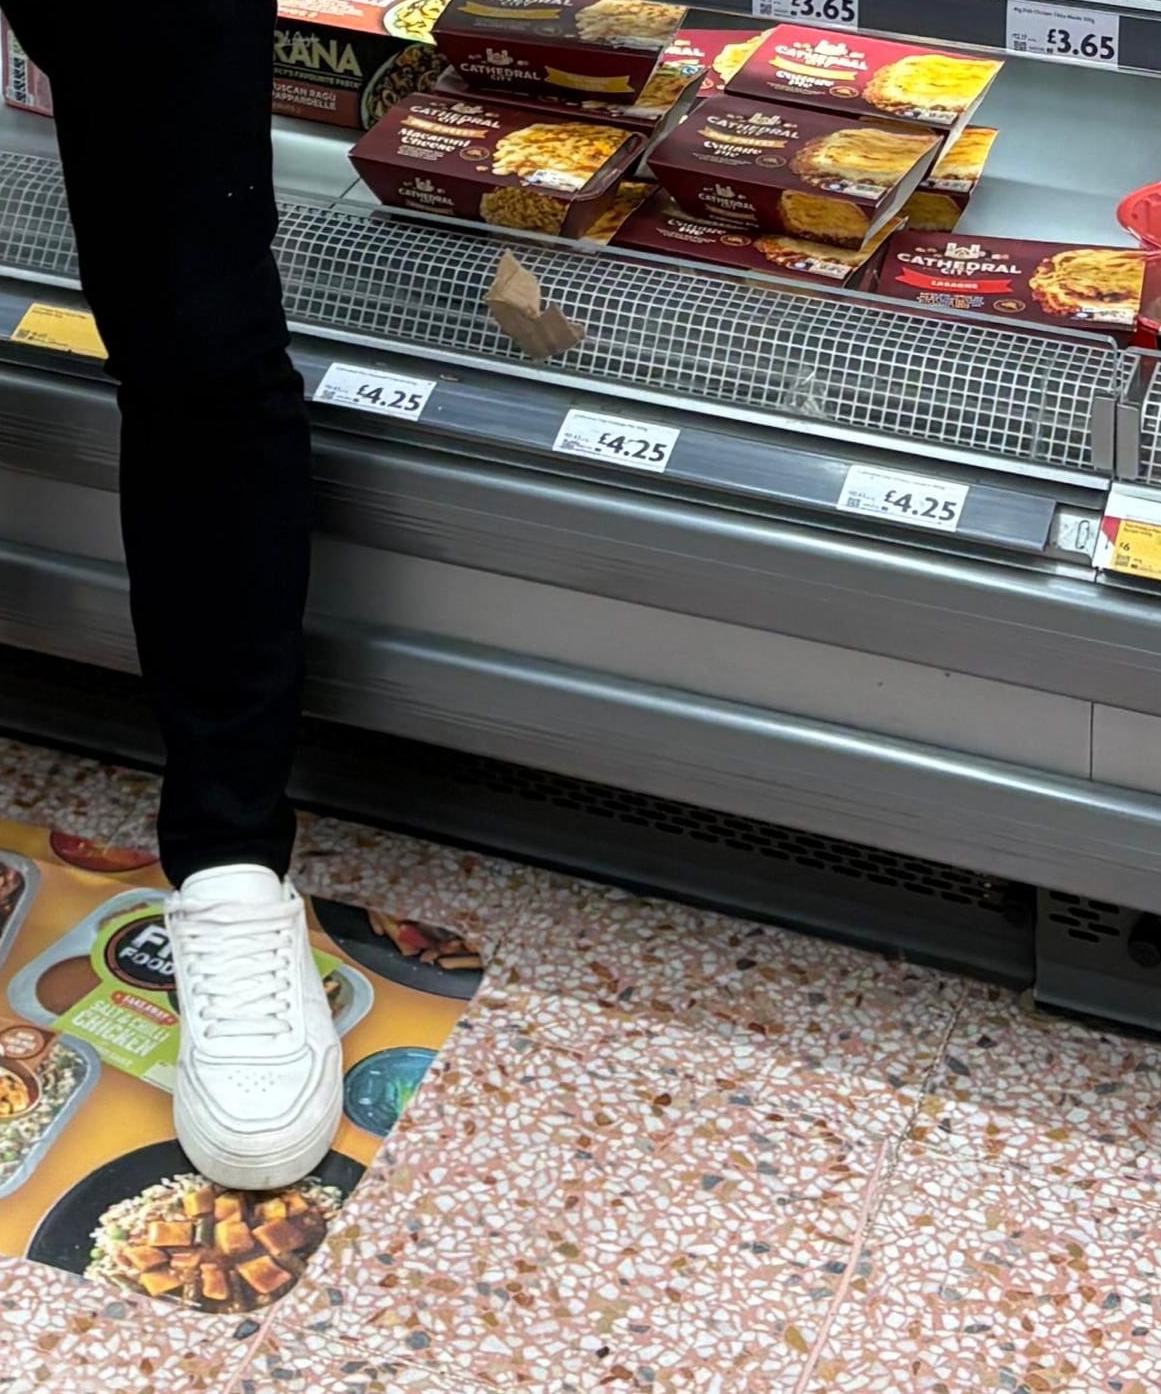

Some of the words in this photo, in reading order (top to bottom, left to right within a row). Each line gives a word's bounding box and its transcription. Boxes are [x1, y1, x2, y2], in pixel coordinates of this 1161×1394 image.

[1047, 28, 1114, 59] £3.65
[459, 62, 540, 80] CATHEDRAL
[409, 104, 500, 129] CATHEDRAL
[706, 114, 800, 140] CATHEDRAL
[897, 252, 1022, 275] CATHEDRAL
[355, 384, 423, 411] £4.25
[598, 430, 667, 462] £4.25
[883, 488, 957, 522] £4.25
[72, 1011, 160, 1057] CHICKEN
